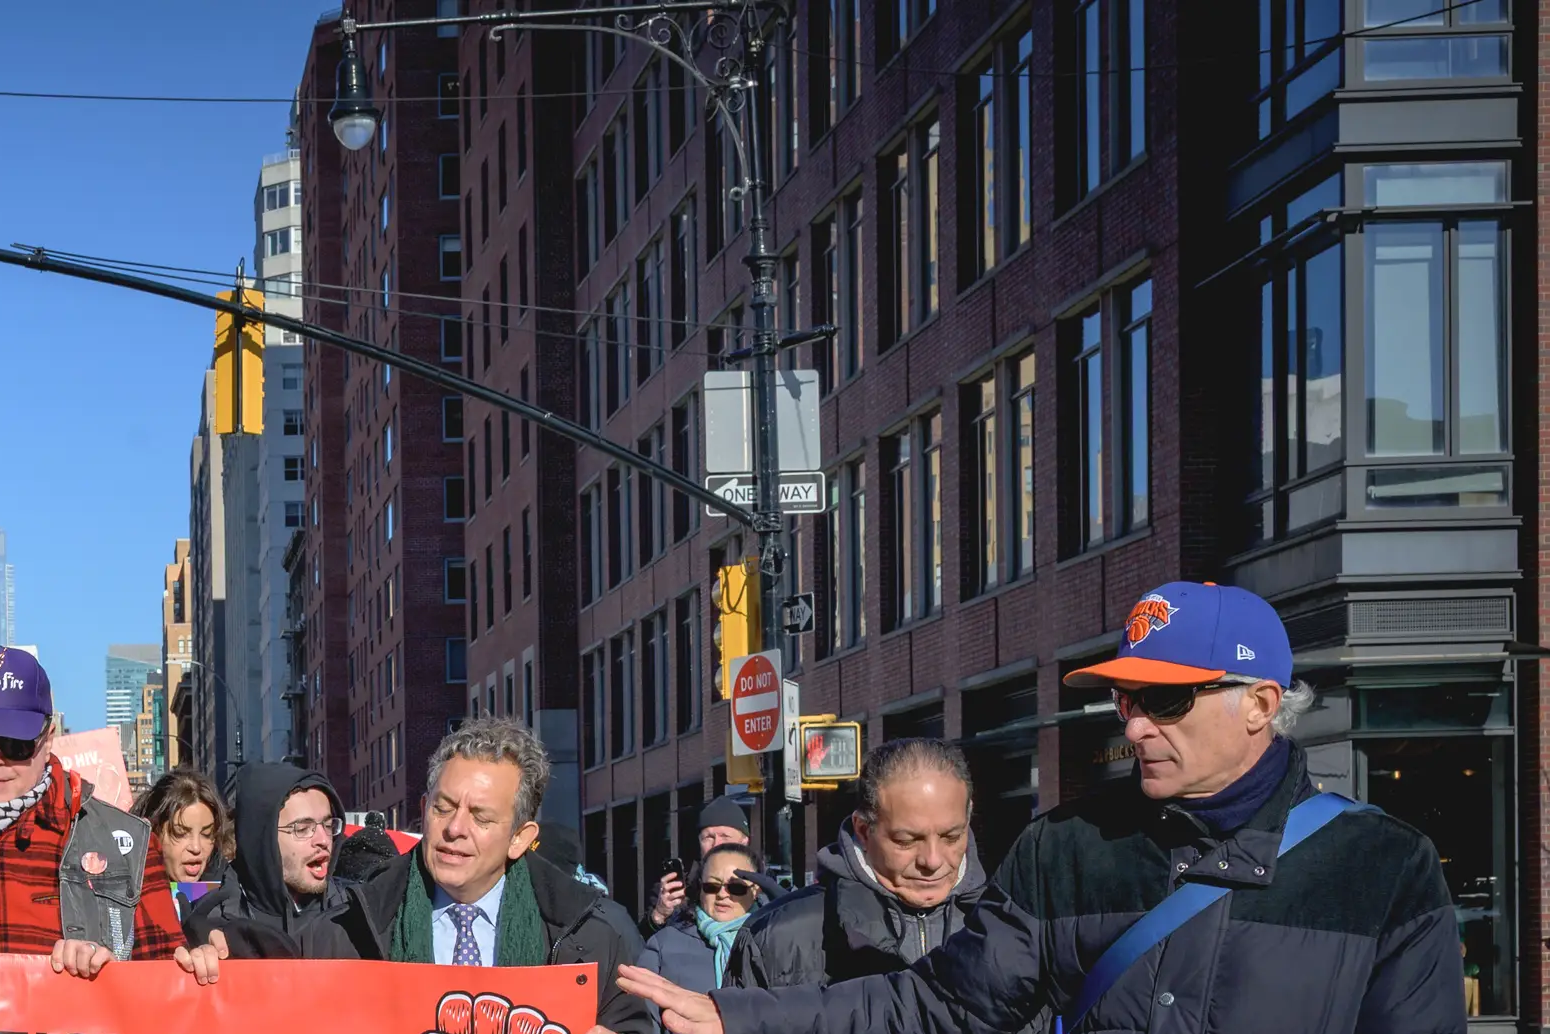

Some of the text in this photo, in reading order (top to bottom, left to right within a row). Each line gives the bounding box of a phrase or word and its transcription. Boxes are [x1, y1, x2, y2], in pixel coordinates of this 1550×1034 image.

[723, 485, 812, 502] ONE WAY
[2, 672, 24, 690] Fire
[740, 672, 772, 692] DO NOT
[744, 715, 772, 734] ENTER
[76, 751, 103, 768] HIV.
